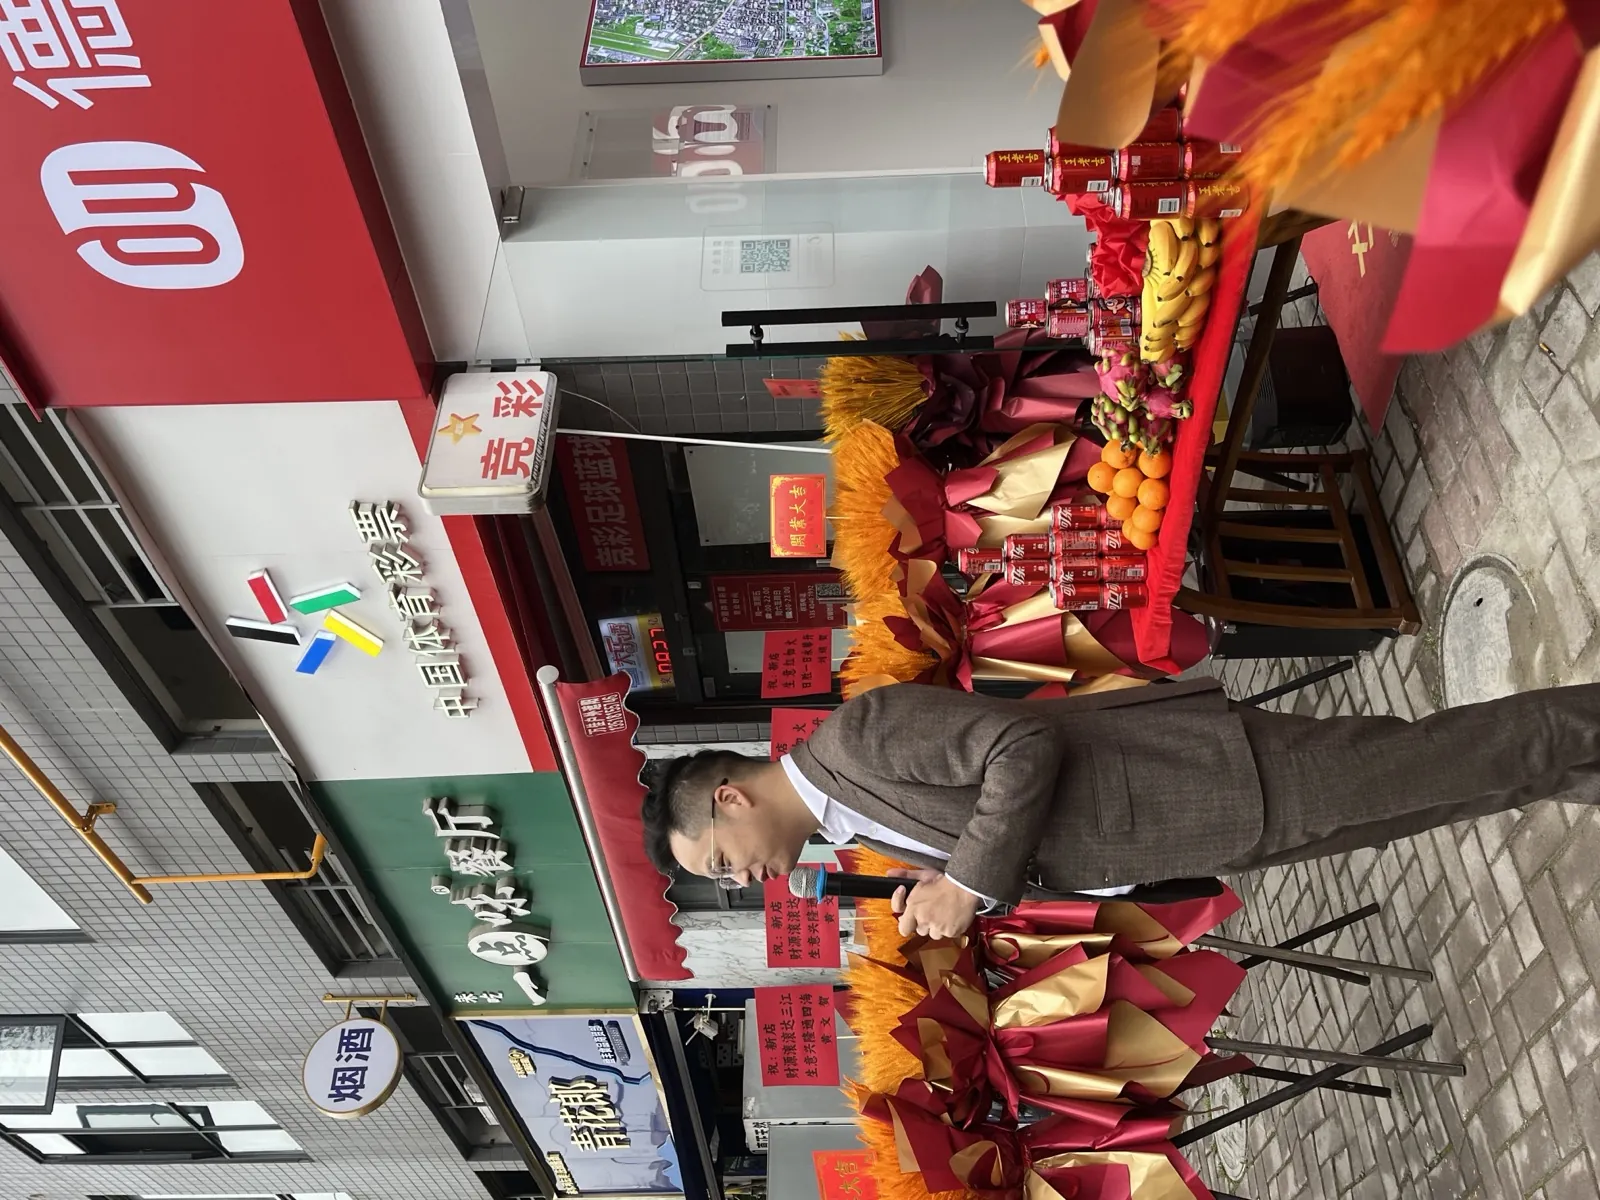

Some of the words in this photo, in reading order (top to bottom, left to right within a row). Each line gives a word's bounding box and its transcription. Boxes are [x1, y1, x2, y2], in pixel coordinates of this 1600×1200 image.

[0, 0, 152, 110] 德
[998, 153, 1039, 163] 王老吉
[1064, 157, 1105, 167] 王老吉
[1198, 185, 1240, 196] 王老吉
[480, 378, 544, 480] 竞彩
[349, 501, 477, 718] 中国体育彩票
[604, 623, 637, 667] 大乐透
[782, 638, 797, 688] 生意红如火
[801, 633, 814, 689] 日胜一日永攀升
[422, 798, 550, 1006] 一点味餐厅
[786, 873, 802, 960] 财源滚滚达
[328, 1028, 375, 1103] 烟酒
[779, 993, 799, 1079] 财源滚滚达三江
[799, 993, 818, 1078] 生意兴隆通四海
[549, 1078, 631, 1152] 青花郎
[834, 1160, 862, 1200] 大吉
